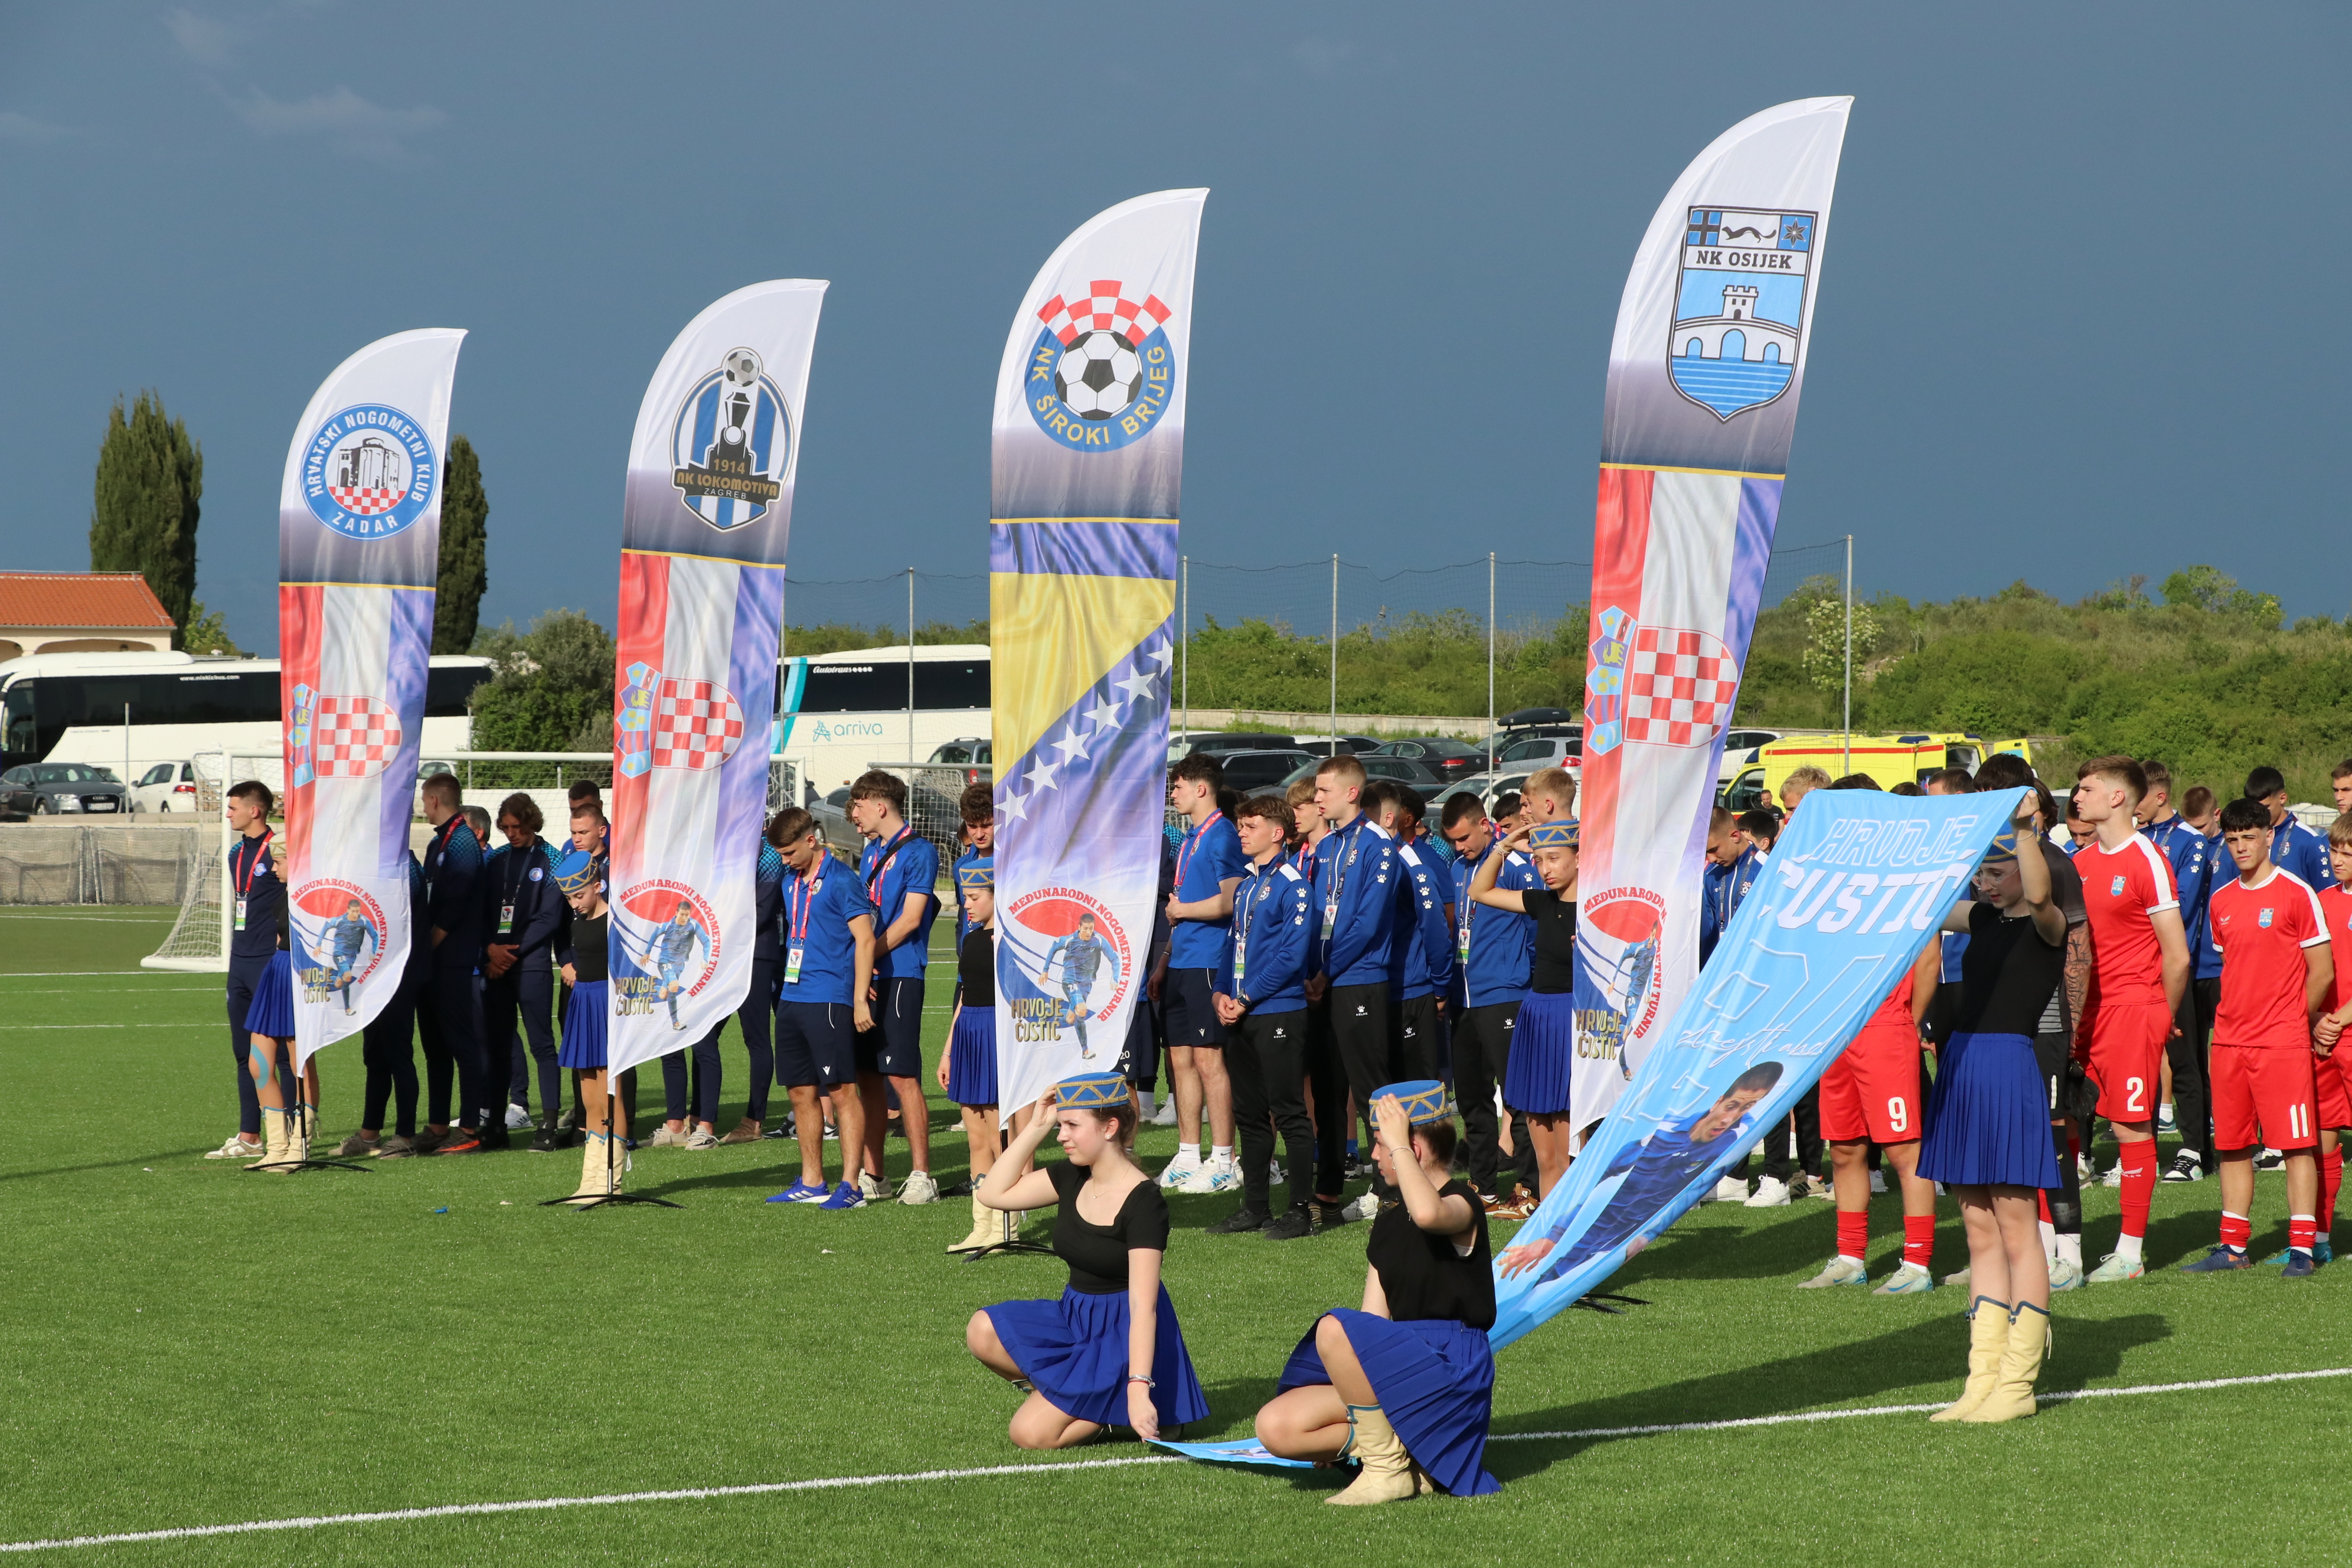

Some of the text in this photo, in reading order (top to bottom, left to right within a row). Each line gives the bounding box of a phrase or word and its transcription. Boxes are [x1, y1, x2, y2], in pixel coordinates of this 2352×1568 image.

[1696, 250, 1793, 269] NK OSIJEK
[1032, 345, 1167, 445] NK ŠIROKI BRIJEG
[307, 410, 430, 502] HRVATSKI NOGOMETNI KLUB
[714, 459, 746, 473] 1914
[677, 472, 778, 496] NK LOKOMOTIVA
[704, 488, 747, 499] ZAGREB
[332, 512, 398, 533] ZADAR
[834, 721, 883, 736] arriva
[1810, 815, 1979, 867] HRVOJE
[290, 878, 387, 985] MEĐUNARODNI NOGOMETNI TURNIR
[619, 878, 721, 998] MEĐUNARODNI NOGOMETNI TURNIR
[1008, 887, 1131, 1022] MEĐUNARODNI NOGOMETNI TURNIR
[1584, 887, 1665, 914] MEĐUNARODN
[1633, 992, 1662, 1040] TURNIR
[615, 975, 658, 995] HRVOJE
[1067, 983, 1079, 993] 24
[1011, 997, 1064, 1018] HRVOJE
[1014, 1018, 1061, 1042] ČUSTIĆ
[1576, 1008, 1623, 1033] HRVOJE
[1120, 1050, 1131, 1060] 20
[2126, 1077, 2144, 1112] 2
[1888, 1096, 1907, 1132] 9
[2290, 1103, 2308, 1139] 11
